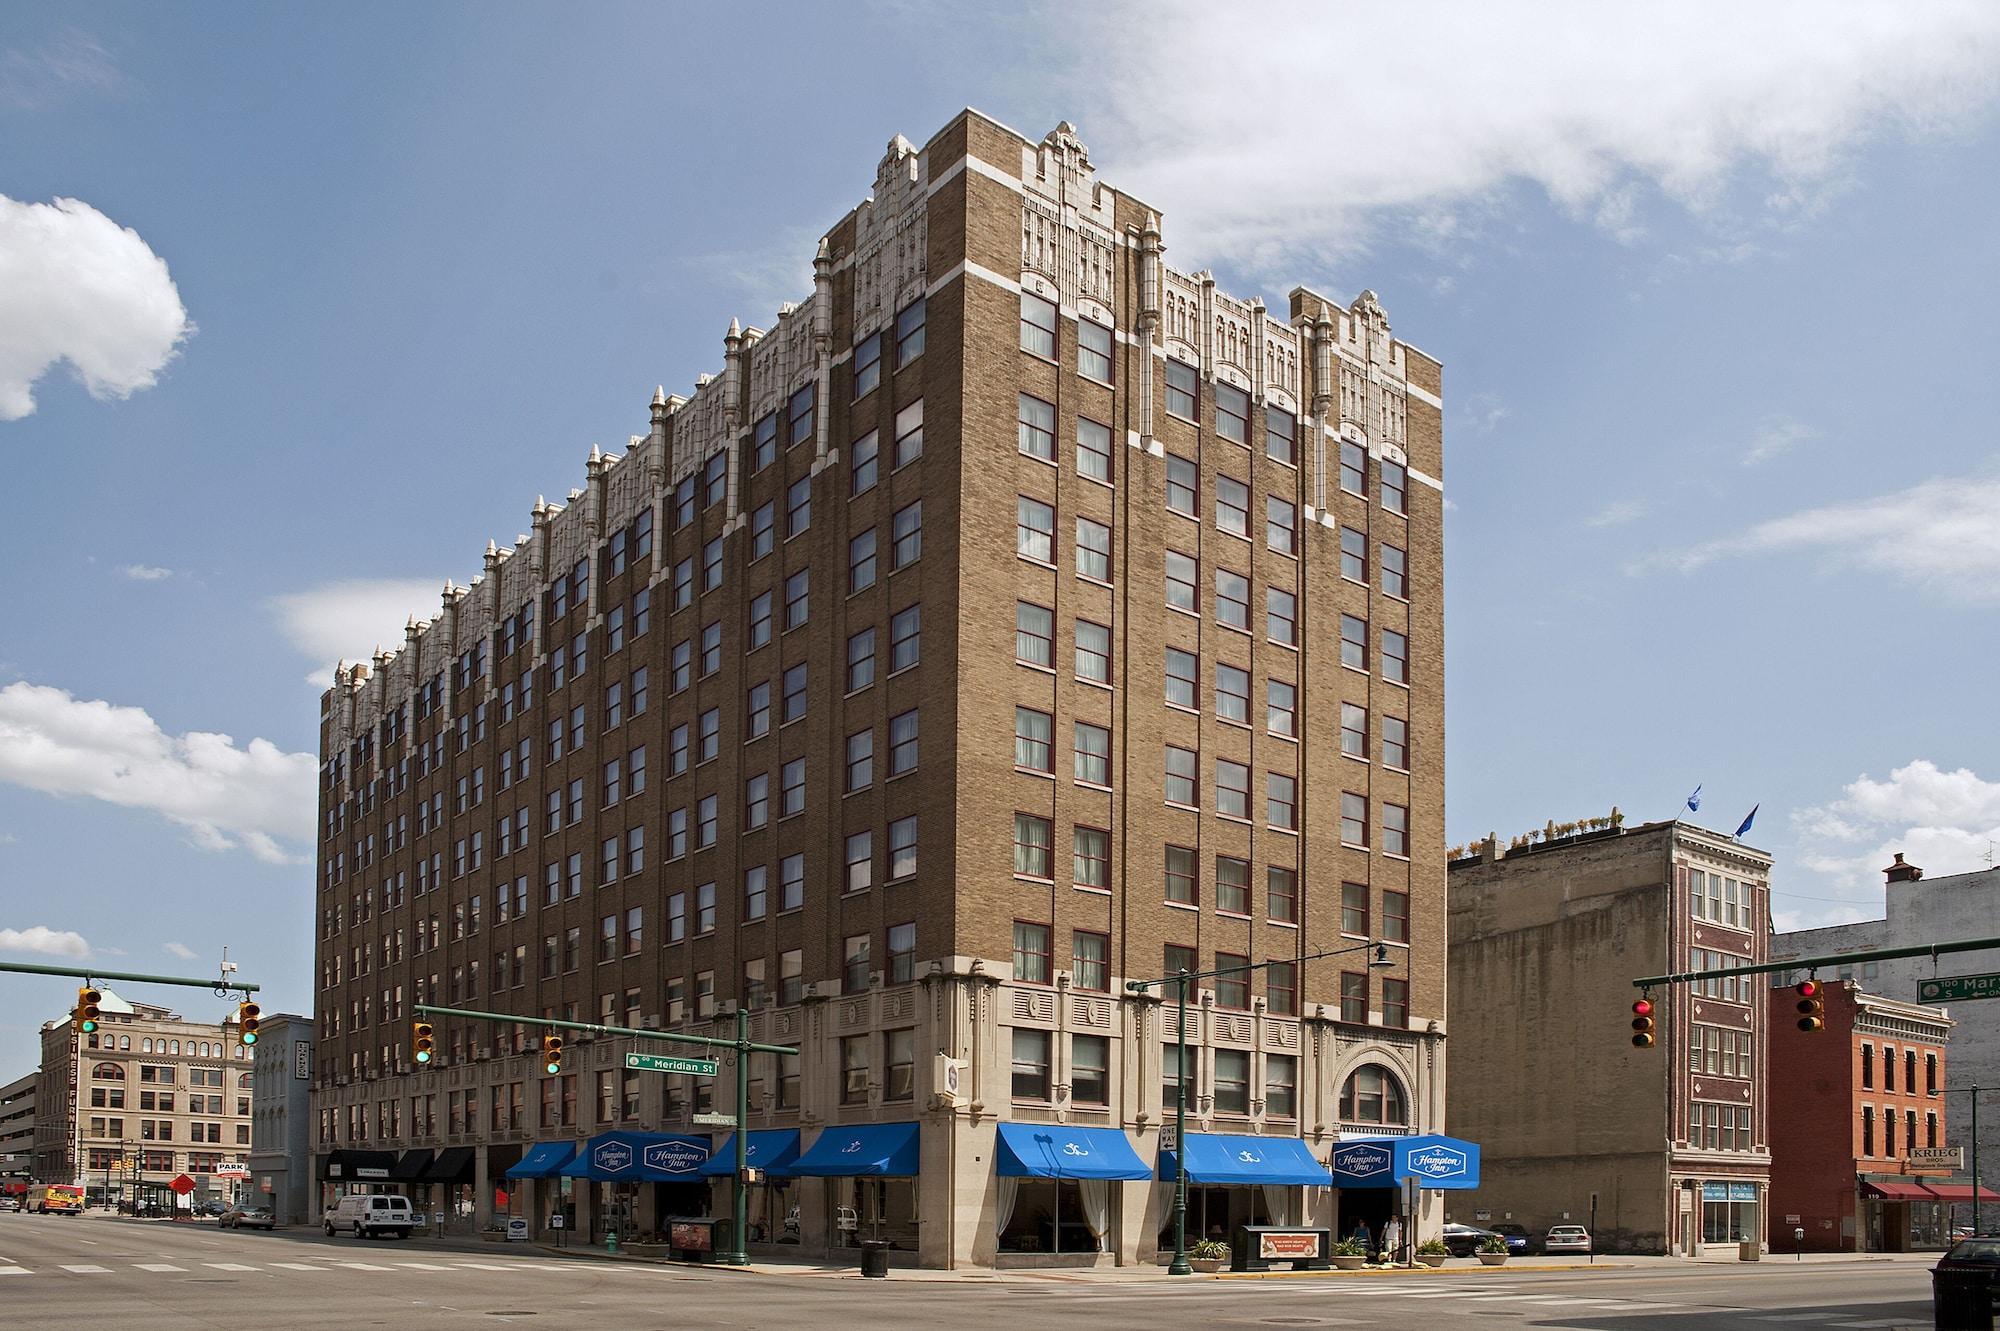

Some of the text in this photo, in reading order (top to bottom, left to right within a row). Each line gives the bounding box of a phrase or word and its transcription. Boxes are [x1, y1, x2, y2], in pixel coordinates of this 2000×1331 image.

[1940, 978, 2000, 990] 100 Mar
[1945, 989, 1953, 998] S
[654, 1060, 698, 1072] Meridian
[703, 1064, 713, 1073] St
[67, 1020, 78, 1163] BUSINESS FURNITURE
[1162, 1135, 1175, 1143] WAY
[598, 1151, 629, 1162] Hampton
[650, 1150, 703, 1163] Hampton
[1914, 1149, 1958, 1158] KRIEG
[605, 1160, 621, 1168] Inn
[663, 1160, 690, 1169] Inn
[1338, 1154, 1386, 1167] Hampton
[1413, 1154, 1462, 1167] Hampton
[1349, 1163, 1374, 1173] Inn
[1425, 1163, 1450, 1173] Inn
